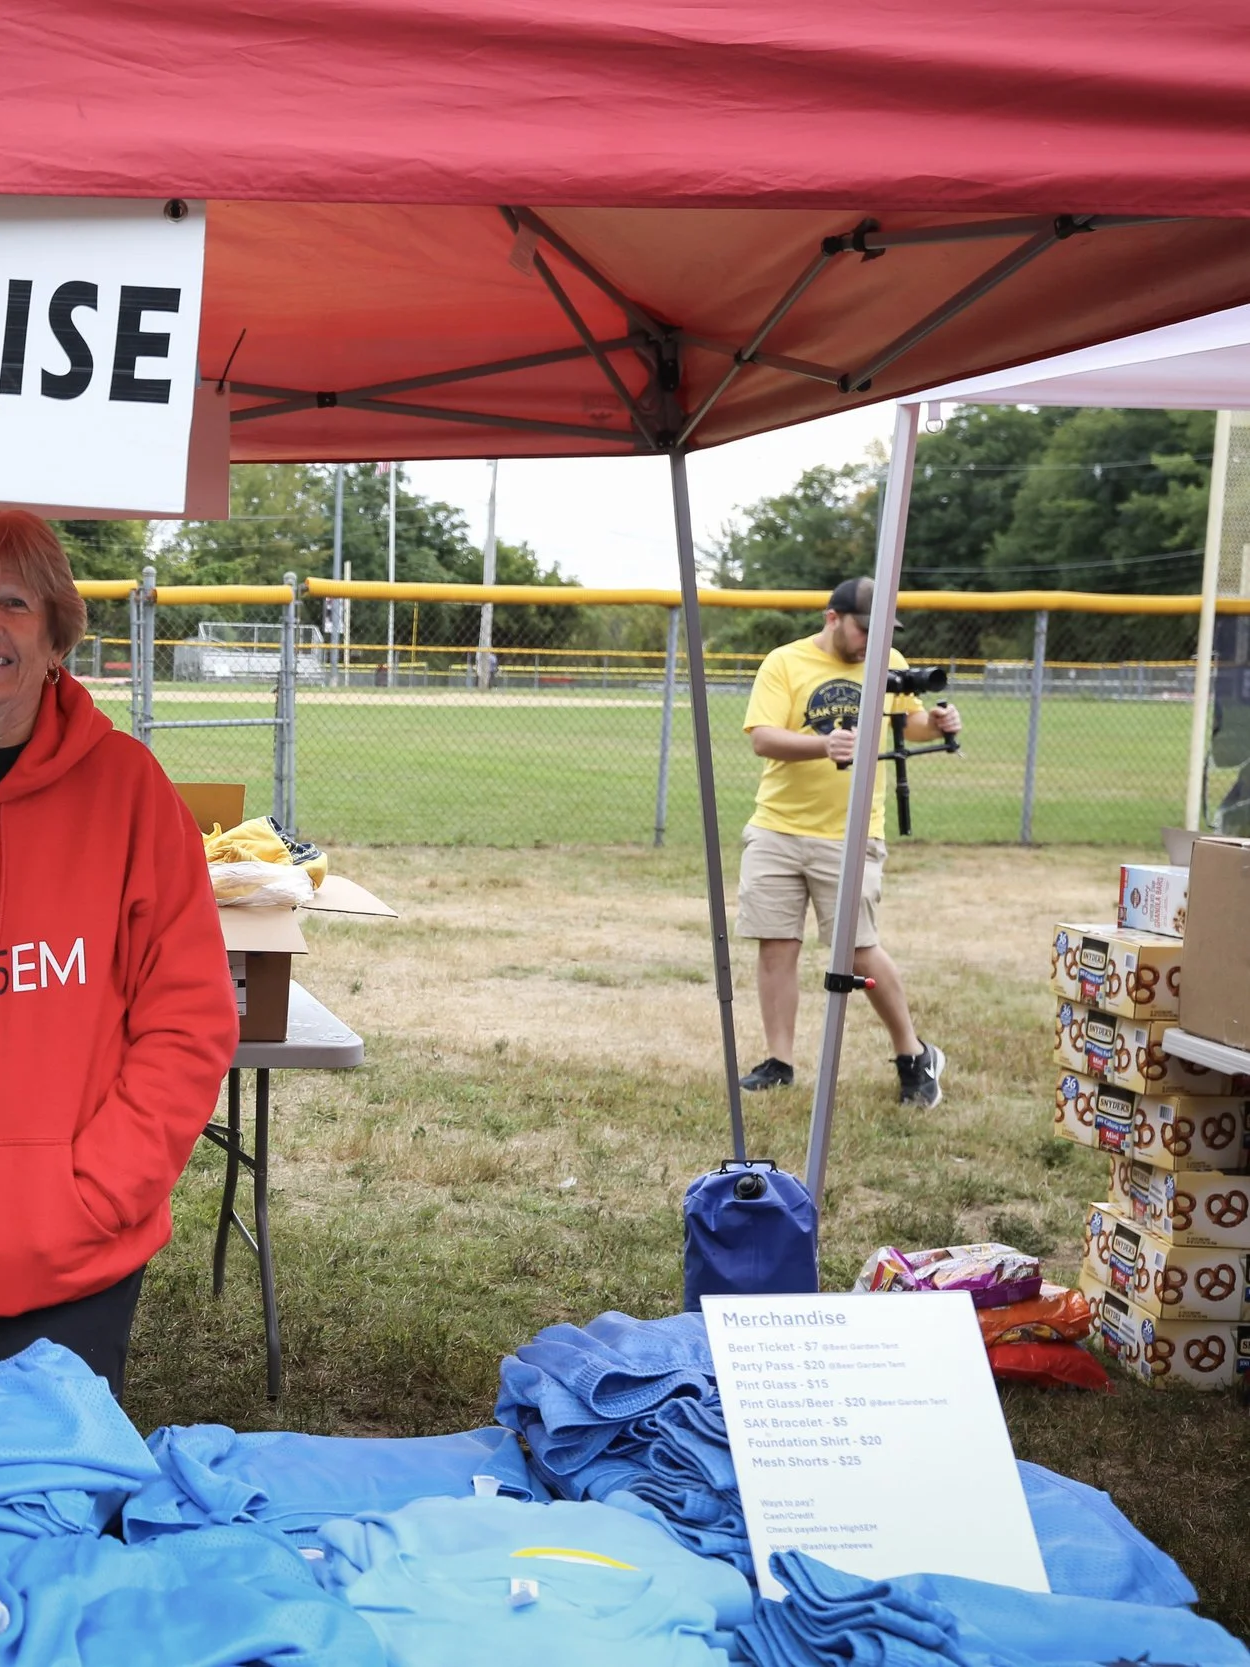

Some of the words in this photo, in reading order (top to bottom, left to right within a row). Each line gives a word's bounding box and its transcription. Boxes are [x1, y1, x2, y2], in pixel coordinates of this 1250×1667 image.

[831, 704, 859, 716] STRO
[1065, 1077, 1076, 1089] 36
[722, 1310, 846, 1326] Merchandise
[1144, 1319, 1152, 1333] 36
[728, 1343, 755, 1352] Beer
[758, 1342, 795, 1352] Ticket
[804, 1341, 818, 1351] $7
[732, 1362, 762, 1373] Party
[765, 1361, 794, 1370] Pass
[803, 1360, 825, 1370] $20
[736, 1380, 760, 1390] Pint
[762, 1379, 797, 1389] Glass
[806, 1379, 829, 1389] $15
[739, 1399, 763, 1409] Pint
[766, 1398, 834, 1408] Glass/Beer
[844, 1397, 866, 1407] $20
[743, 1418, 769, 1428] SAK
[770, 1417, 823, 1428] Bracelet
[832, 1416, 848, 1427] $5
[748, 1436, 818, 1448] Foundation
[820, 1436, 851, 1446] Shirt
[860, 1435, 882, 1446] $20
[751, 1457, 785, 1468] Mesh
[788, 1456, 829, 1467] Shorts
[838, 1455, 862, 1466] $25
